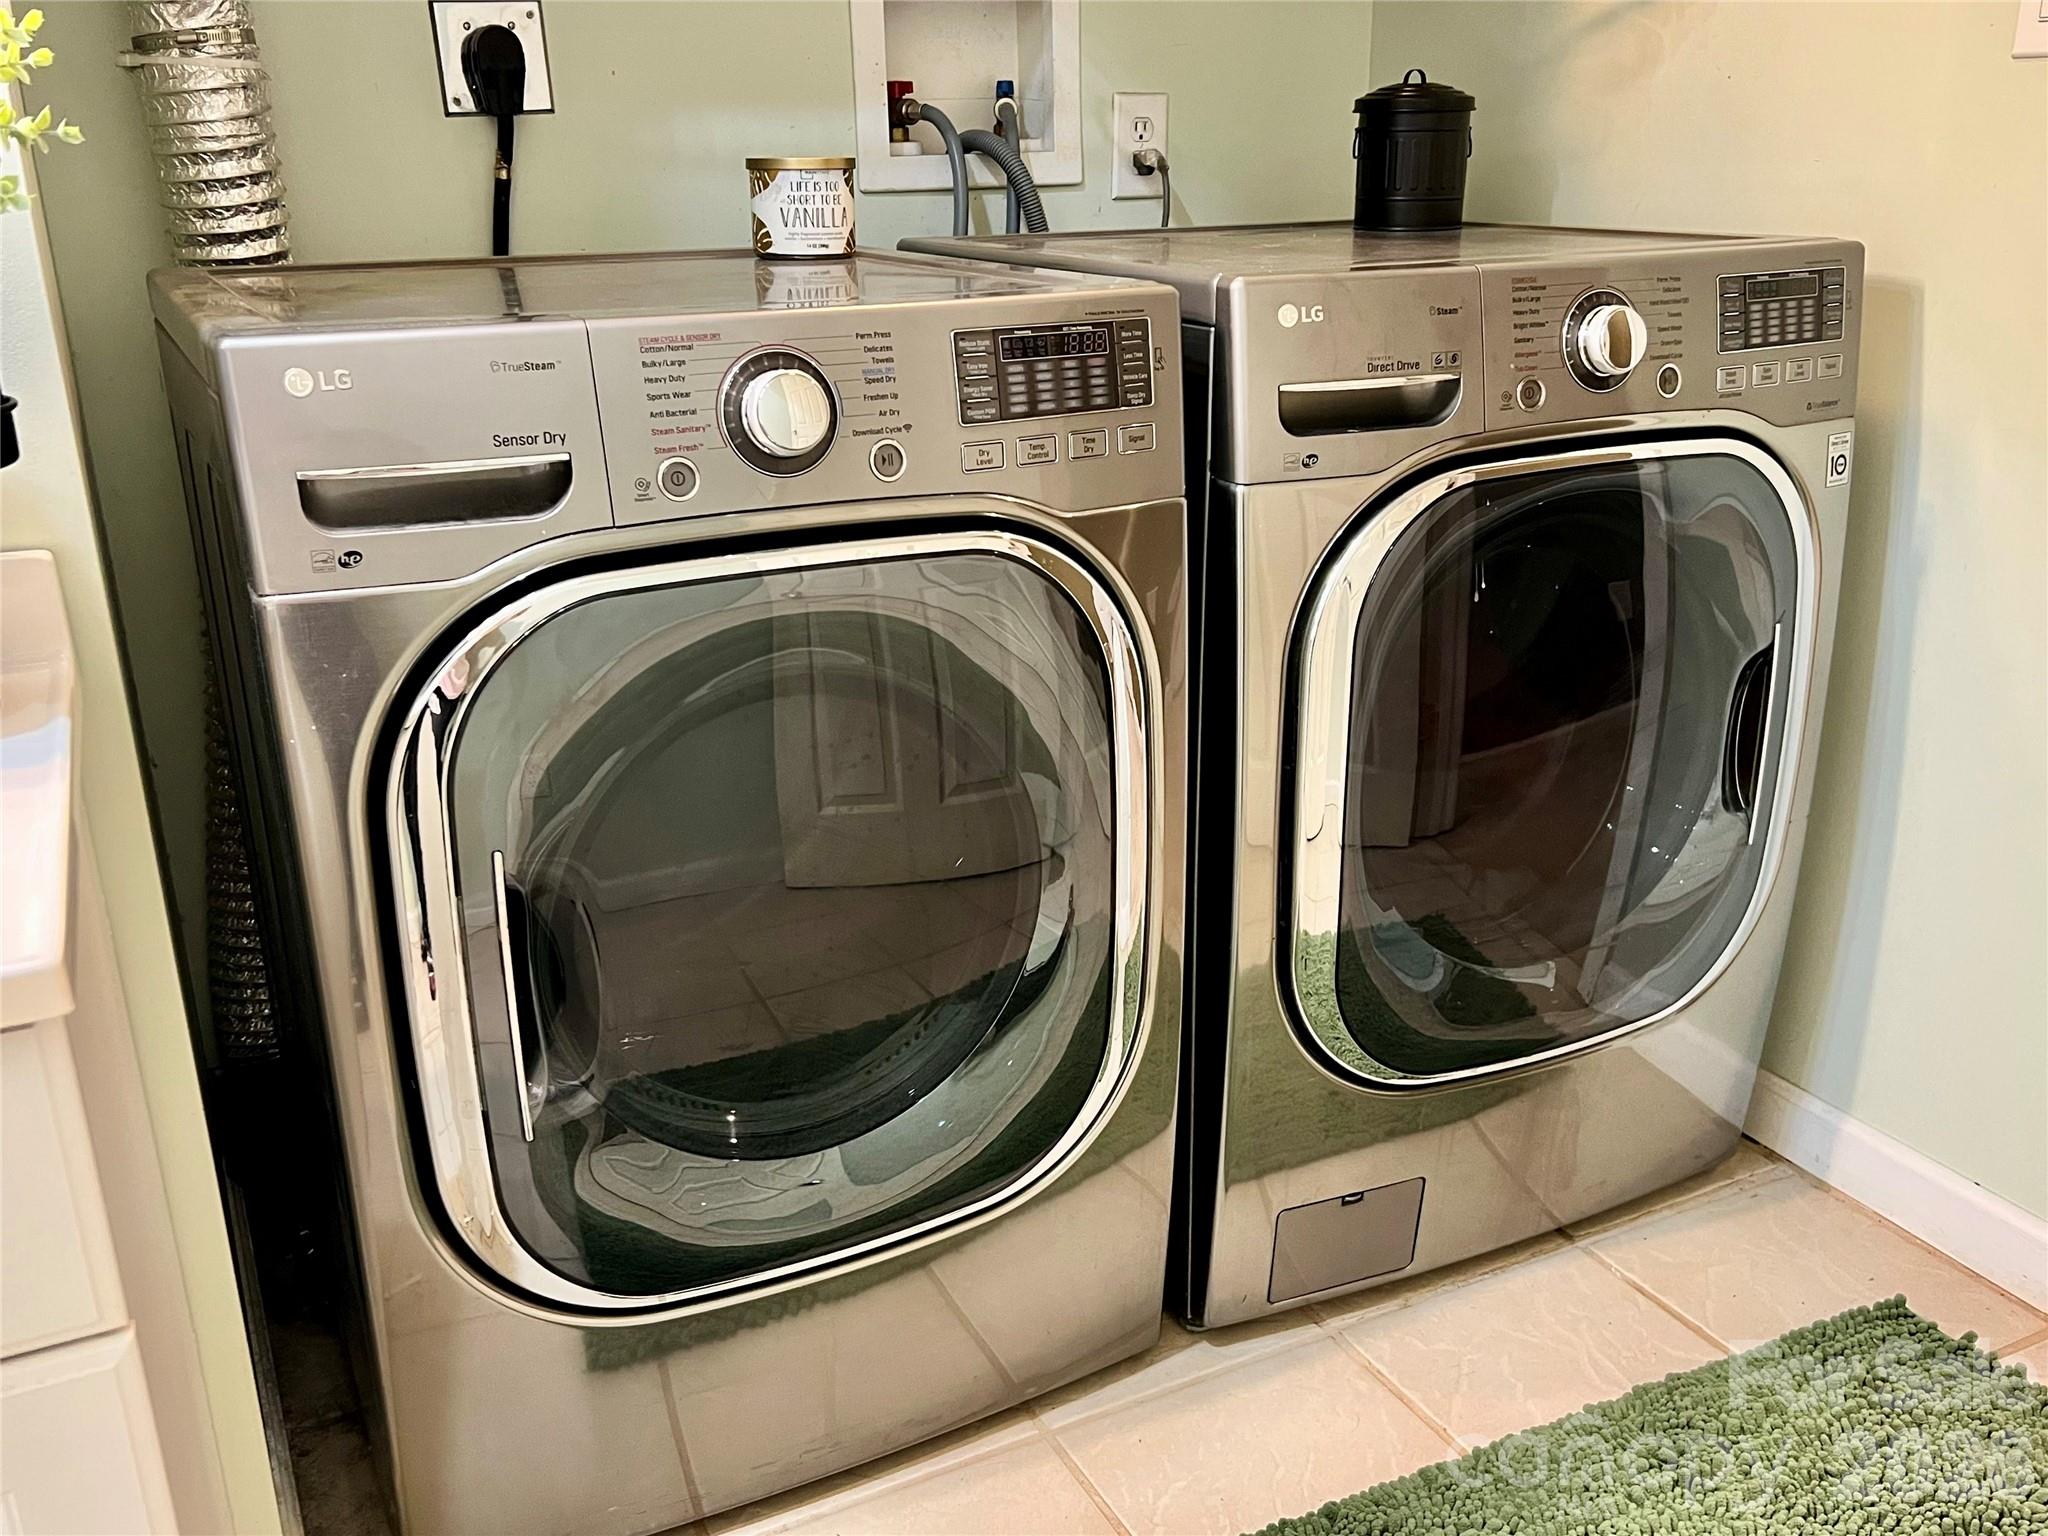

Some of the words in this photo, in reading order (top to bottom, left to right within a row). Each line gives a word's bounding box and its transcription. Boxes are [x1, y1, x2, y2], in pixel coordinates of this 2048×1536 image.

[790, 181, 810, 192] LIFE
[814, 181, 822, 192] IS
[825, 181, 839, 192] TOO
[787, 194, 816, 205] SHORT
[821, 194, 830, 205] TO
[833, 194, 842, 205] BE
[780, 207, 848, 228] VANILLA
[1301, 306, 1324, 322] LG
[1437, 307, 1458, 315] Steam
[640, 344, 694, 354] Cotton/Normal
[864, 345, 893, 353] Delicates
[642, 360, 686, 368] Bulky/Large
[1367, 362, 1394, 373] Direct
[1397, 360, 1420, 370] Drive
[318, 369, 352, 391] LG
[644, 376, 667, 384] Heavy
[668, 374, 686, 382] Duty
[886, 375, 896, 383] Dry
[646, 393, 671, 402] Sports
[672, 391, 692, 399] Wear
[863, 393, 888, 401] Freshen
[666, 408, 697, 417] Bacterial
[651, 428, 674, 436] Steam
[852, 428, 884, 437] Download
[885, 426, 902, 434] Cycle
[493, 434, 539, 447] Sensor
[543, 431, 566, 446] Dry
[1082, 436, 1096, 444] Time
[1128, 434, 1145, 444] Signal
[654, 446, 677, 454] Steam
[978, 449, 990, 458] Dry
[1084, 445, 1094, 453] Dry
[1027, 451, 1050, 460] Control
[976, 457, 993, 466] Level
